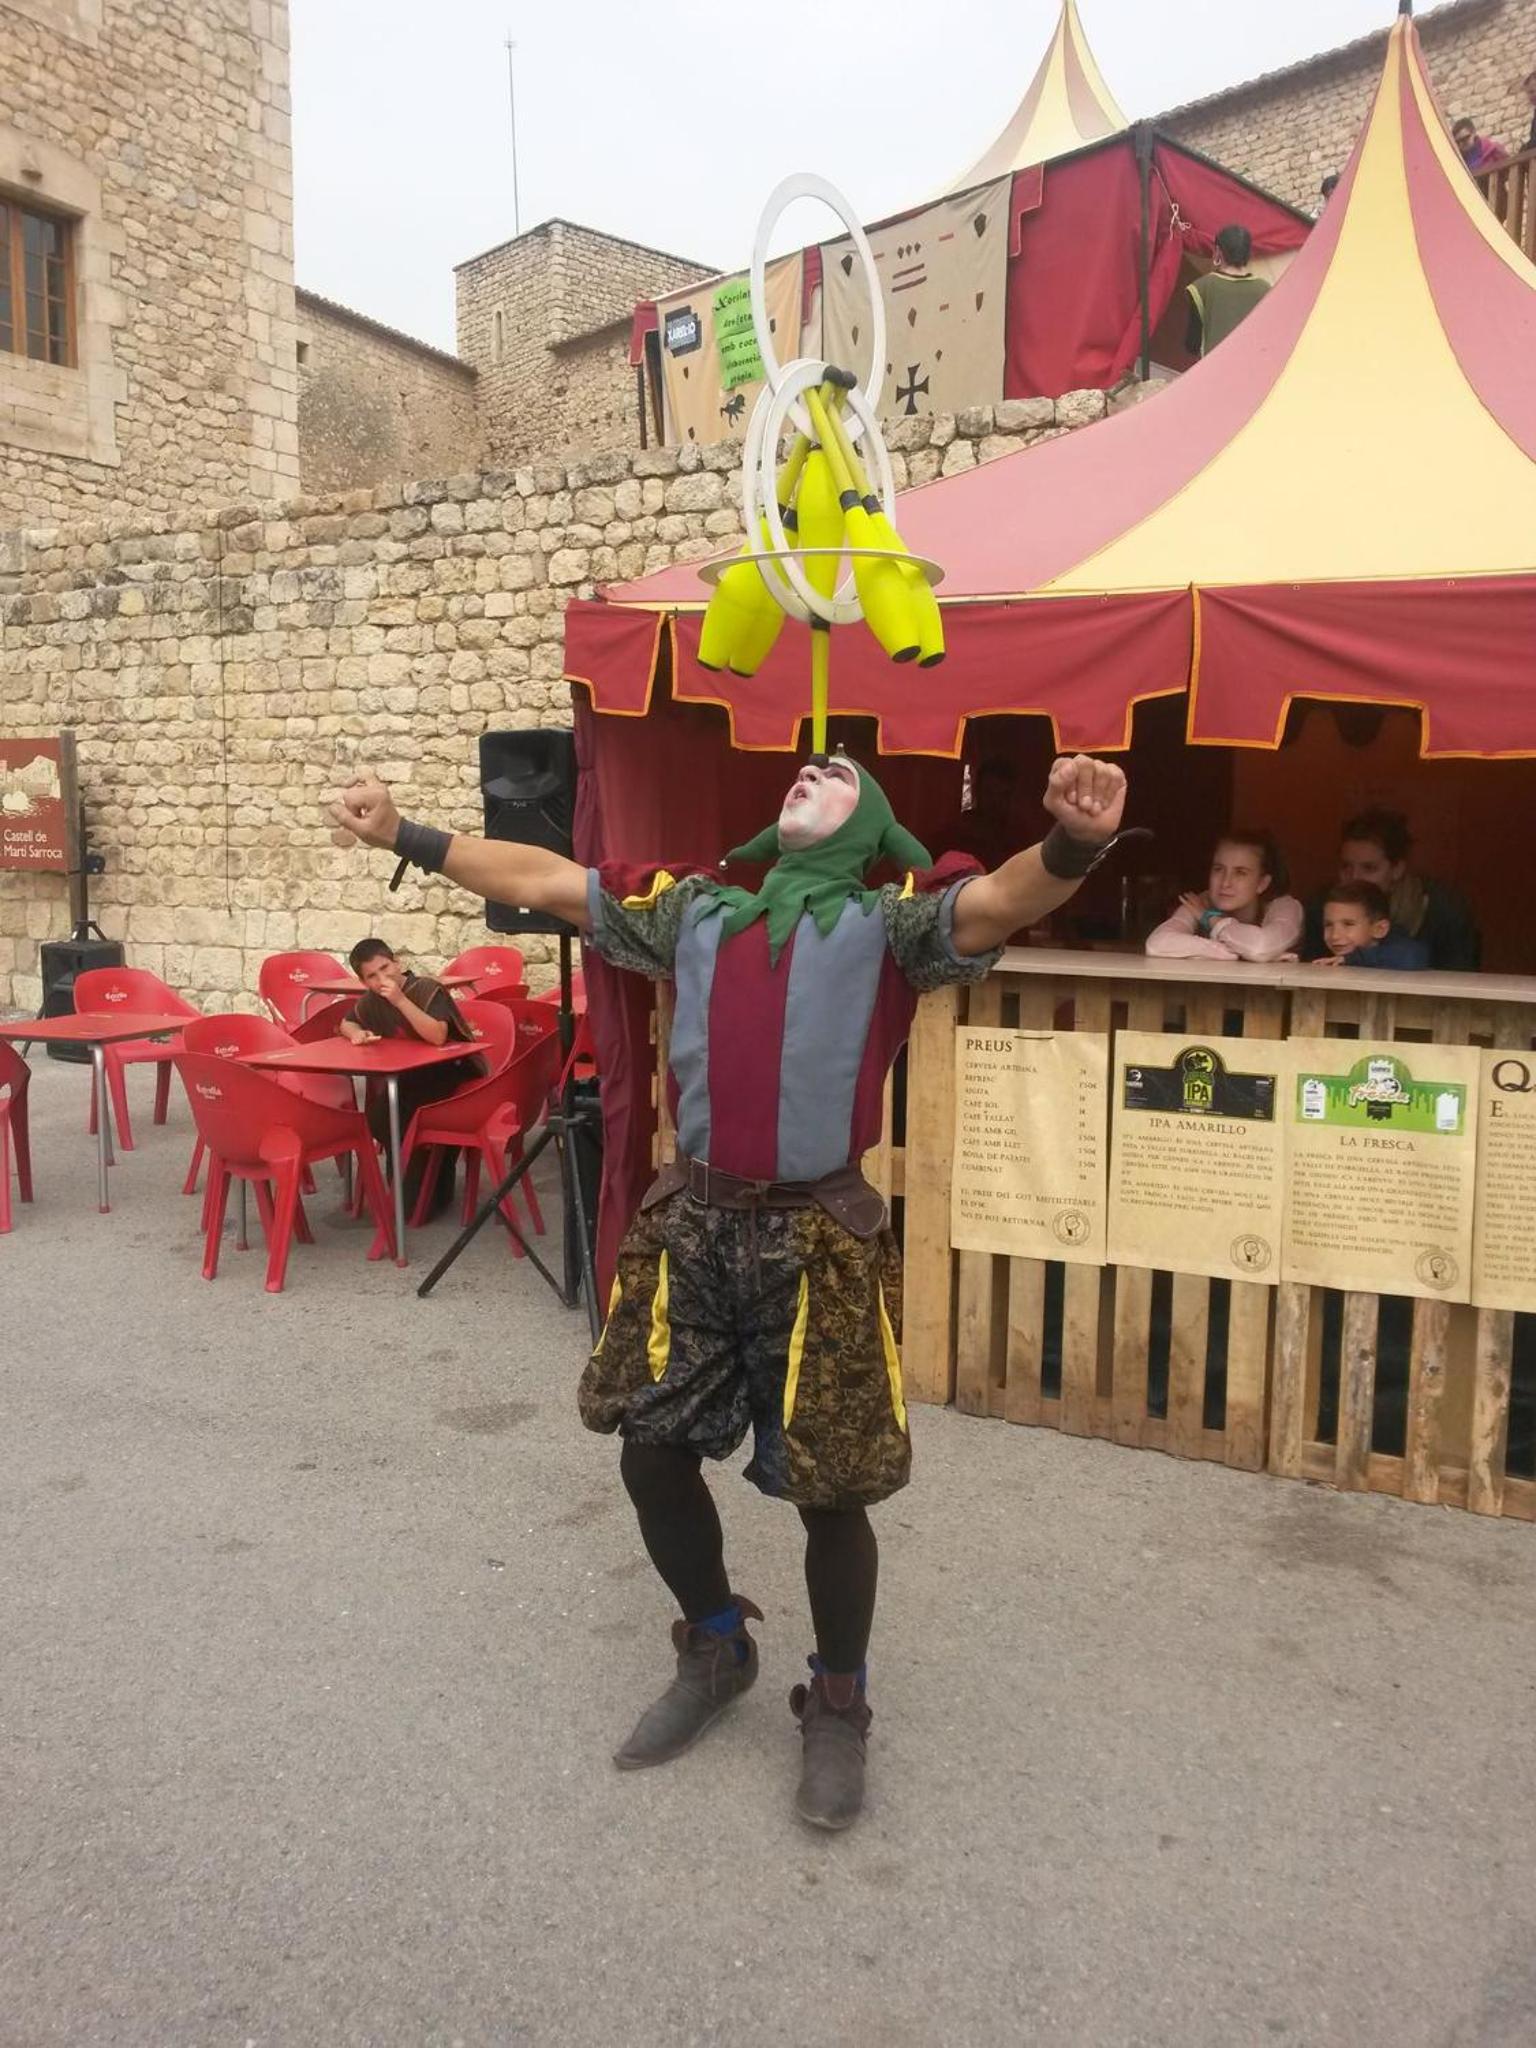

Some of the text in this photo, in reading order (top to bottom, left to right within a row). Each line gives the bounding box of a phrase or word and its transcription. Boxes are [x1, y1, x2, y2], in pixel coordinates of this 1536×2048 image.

[4, 829, 48, 843] Castell de
[29, 845, 63, 859] Sarroca
[966, 1039, 1013, 1053] PREUS
[1186, 1081, 1209, 1103] IPA
[1150, 1118, 1247, 1136] IPA AMARILLO
[1340, 1136, 1416, 1152] LA FRESCA
